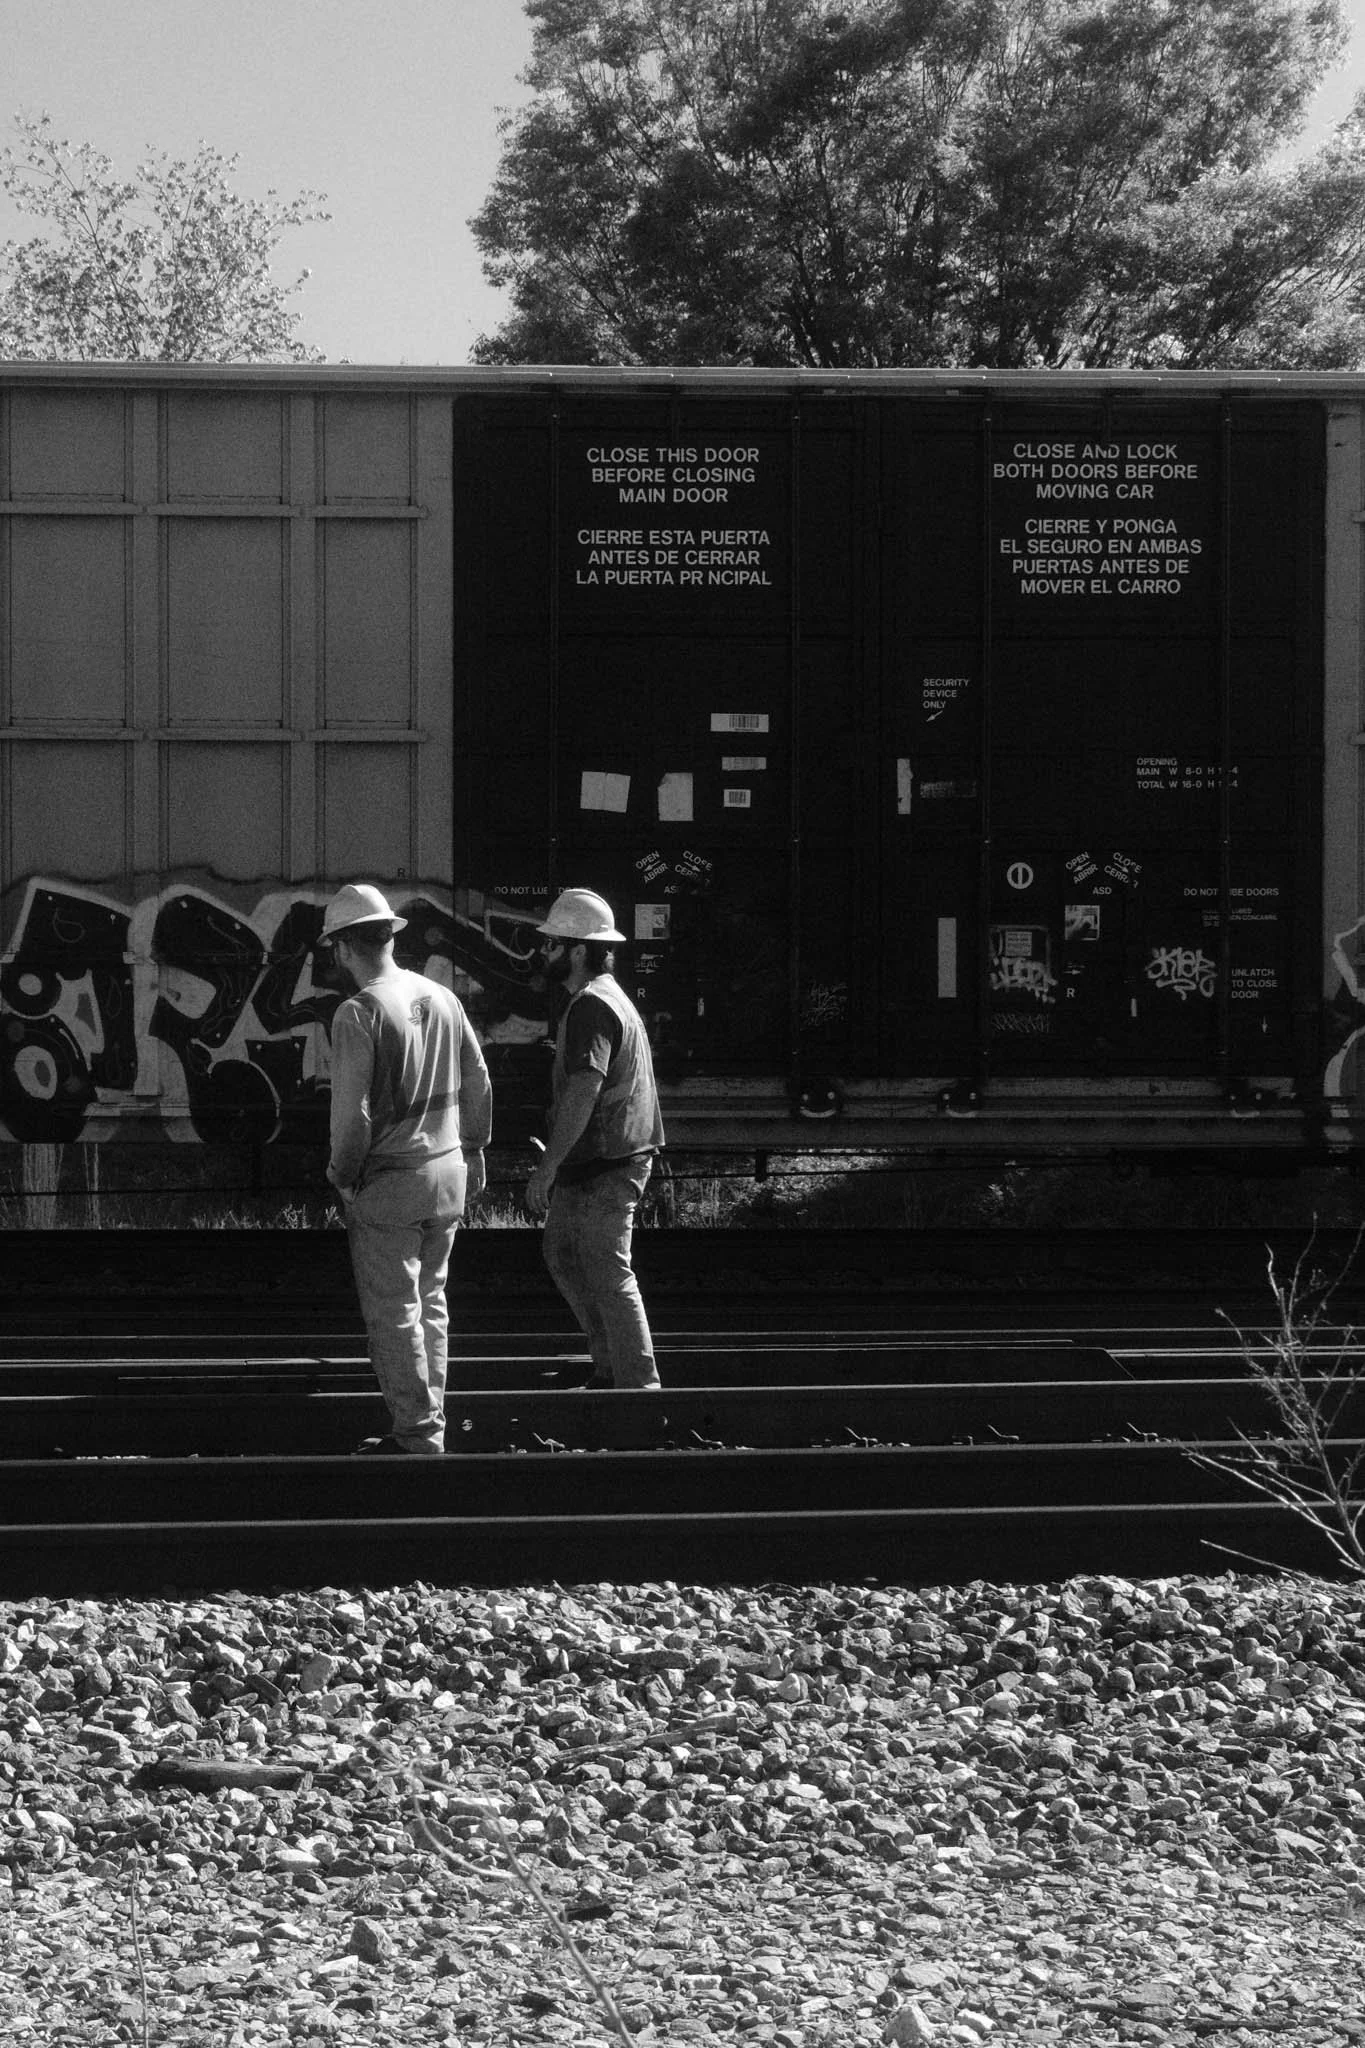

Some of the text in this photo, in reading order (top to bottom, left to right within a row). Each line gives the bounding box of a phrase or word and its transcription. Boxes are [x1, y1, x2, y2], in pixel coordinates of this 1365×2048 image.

[586, 448, 760, 463] CLOSE THIS DOOR
[1013, 443, 1178, 460] CLOSE AND LOCK
[592, 468, 756, 483] BEFORE CLOSING
[993, 464, 1198, 479] BOTH DOORS BEFORE
[619, 488, 728, 503] MAIN DOOR
[1036, 483, 1154, 499] MOVING CAR
[1024, 519, 1177, 534] CIERRE Y PONGA
[577, 530, 770, 545] CIERRE ESTA PUERTA
[1000, 539, 1202, 554] EL SEGURO EN AMBAS
[588, 550, 760, 565] ANTES DE CERRAR
[1012, 559, 1190, 574] PUERTAS ANTES DE
[576, 570, 772, 585] LA PUERTA PRNCIPAL
[1021, 579, 1181, 594] MOVER EL CARRO
[923, 678, 969, 687] SECURITY
[923, 689, 957, 698] DEVICE
[923, 700, 946, 709] ONLY
[1136, 758, 1178, 766] OPENING
[1137, 781, 1164, 789] TOTAL
[1208, 780, 1214, 788] H
[635, 850, 660, 869] OPEN
[1065, 851, 1090, 870] OPEN
[397, 867, 406, 878] R
[644, 863, 668, 884] ABRIR
[1073, 864, 1099, 884] ABRIR
[495, 886, 508, 894] DO
[511, 886, 530, 894] NOT
[1093, 887, 1112, 895] ASD
[1184, 888, 1198, 896] DO
[1200, 888, 1218, 896] NOT
[1246, 888, 1280, 896] DOORS
[1231, 968, 1274, 977] UNLATCH
[637, 988, 646, 998] R
[1066, 988, 1076, 998] R
[1231, 991, 1259, 999] DOOR
